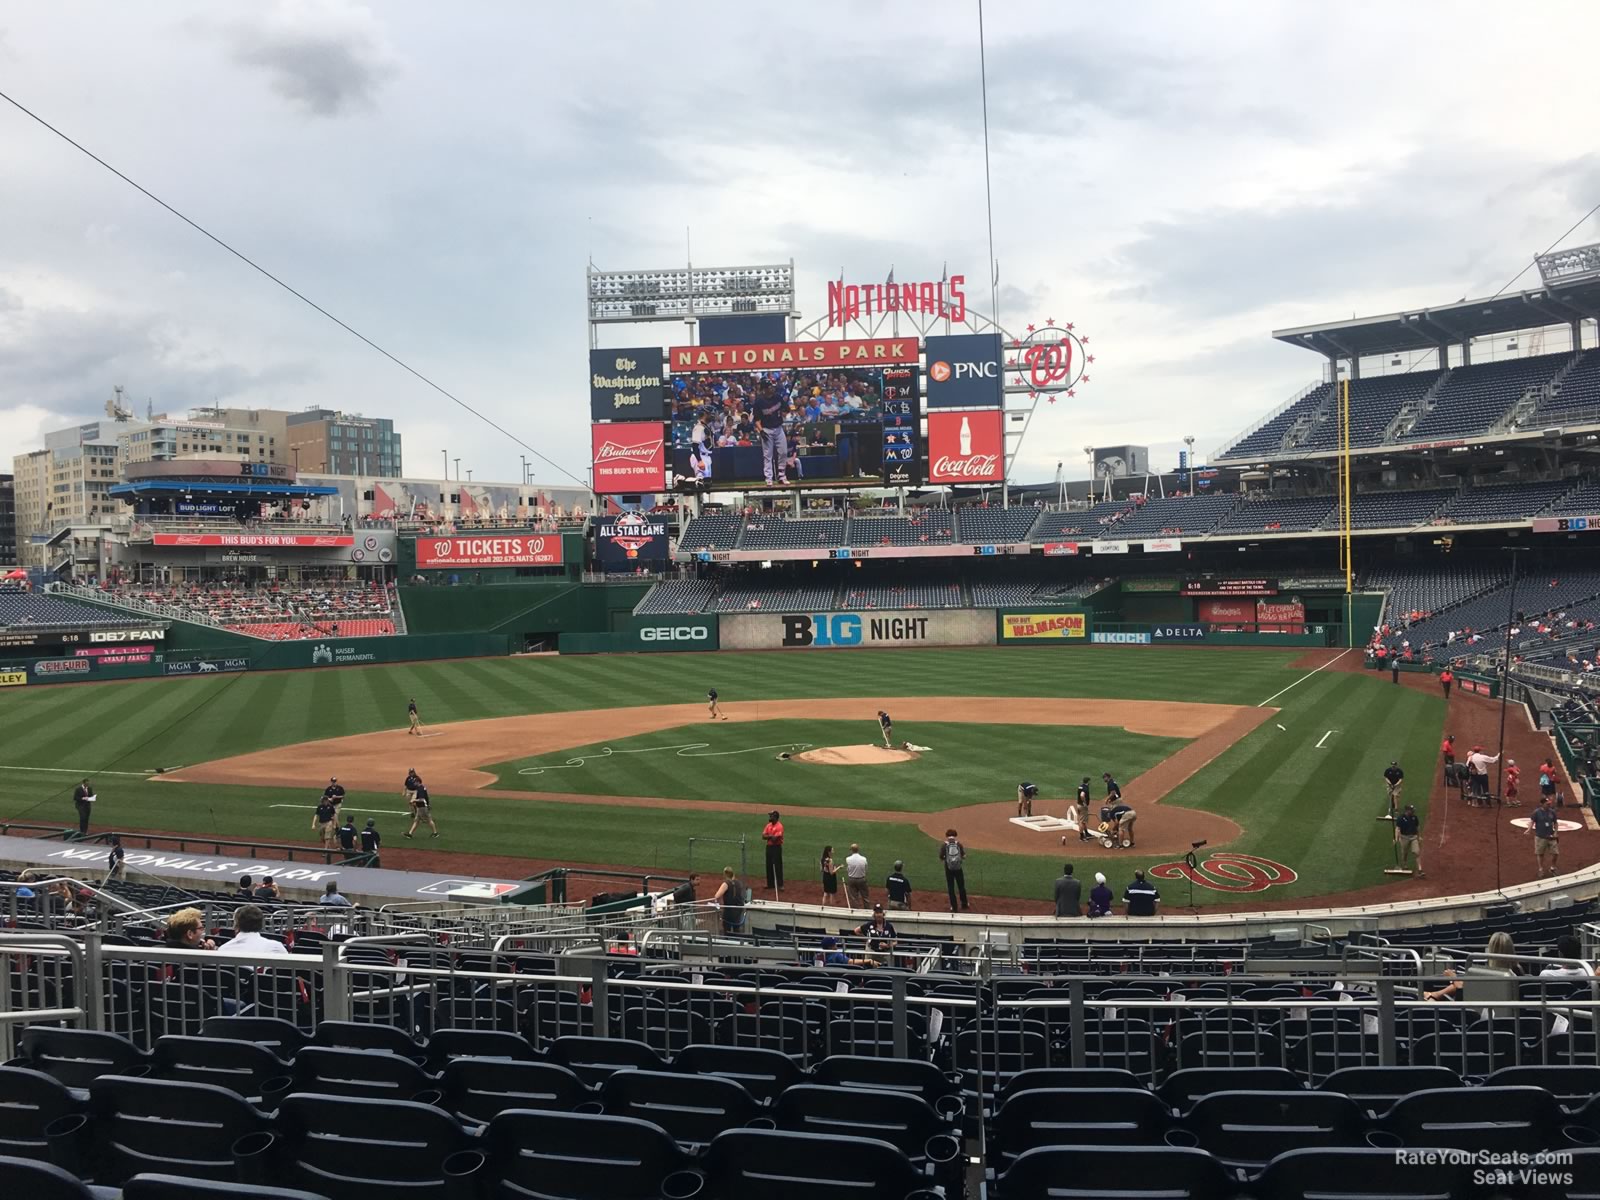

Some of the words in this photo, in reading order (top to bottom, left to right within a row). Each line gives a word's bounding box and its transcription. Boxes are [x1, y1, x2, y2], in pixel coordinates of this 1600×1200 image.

[828, 275, 965, 328] NATIONALS
[680, 348, 825, 366] NATIONALS
[840, 344, 904, 360] PARK
[615, 358, 637, 372] The
[953, 362, 998, 379] PNC
[593, 373, 660, 390] Washington
[614, 393, 641, 409] Post
[599, 446, 657, 458] Budweiser
[600, 467, 613, 475] THIS
[614, 467, 631, 475] BUD'S
[633, 466, 645, 474] FOR
[933, 453, 998, 478] Coca-Cola
[890, 473, 909, 481] Degree
[600, 525, 616, 537] ALL
[617, 525, 641, 537] STAR
[641, 524, 665, 536] GAME
[221, 536, 239, 545] THIS
[240, 536, 263, 545] BUD'S
[265, 536, 280, 545] FOR
[281, 536, 299, 545] YOU.
[456, 539, 522, 556] TICKETS
[851, 549, 869, 558] NIGHT
[996, 545, 1015, 554] NIGHT
[712, 552, 730, 561] NIGHT
[130, 630, 165, 641] FAN
[640, 626, 709, 641] GEICO
[782, 613, 863, 647] BIG
[871, 617, 928, 641] NIGHT
[1166, 628, 1204, 637] DELTA
[336, 647, 355, 655] KAISER
[168, 662, 191, 671] MGM
[224, 659, 246, 667] MGM
[231, 864, 342, 882] PARK
